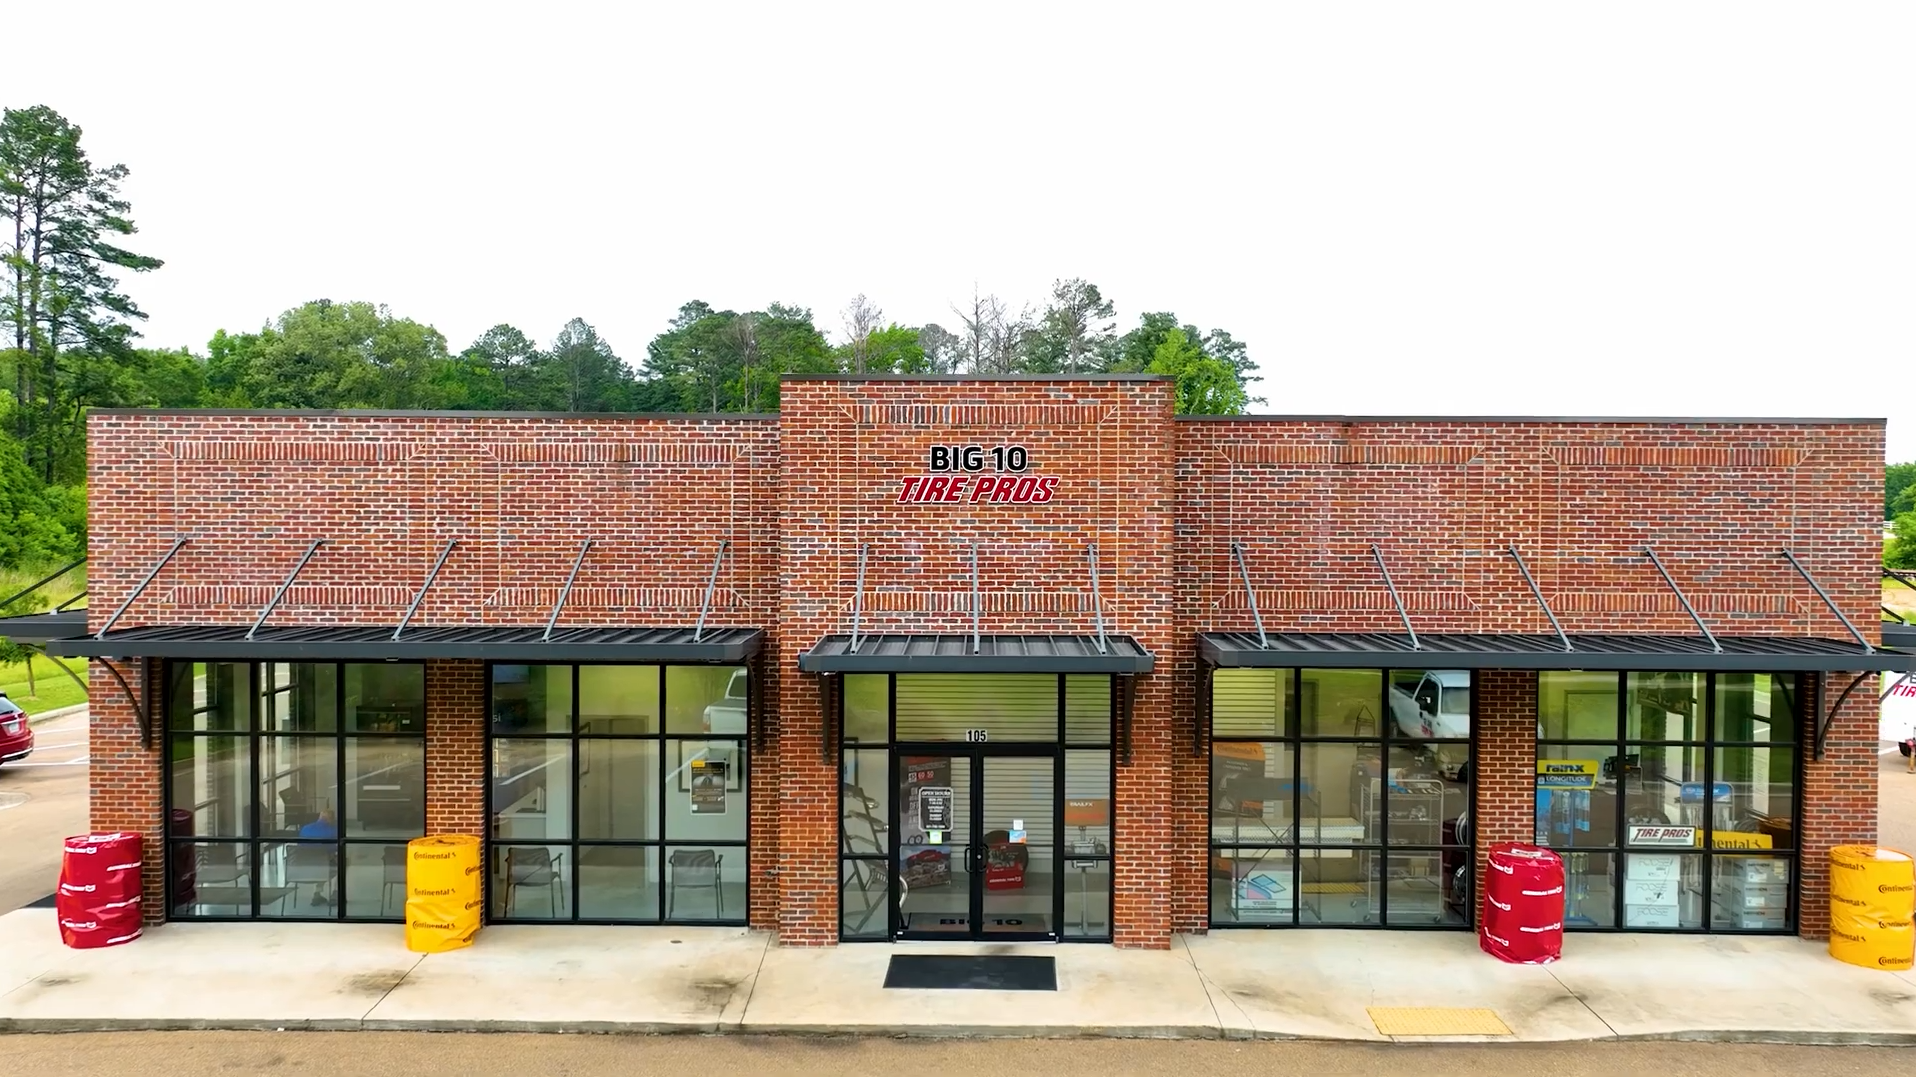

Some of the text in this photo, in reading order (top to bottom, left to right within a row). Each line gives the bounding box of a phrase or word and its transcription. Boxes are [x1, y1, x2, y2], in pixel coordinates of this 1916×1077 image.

[930, 446, 1028, 472] BIG 10
[897, 476, 1060, 503] TIRE PROS
[1893, 683, 1916, 698] TIR
[967, 729, 986, 742] 105
[1546, 775, 1586, 783] LONGITUDE
[1632, 828, 1693, 842] TIRE PROS
